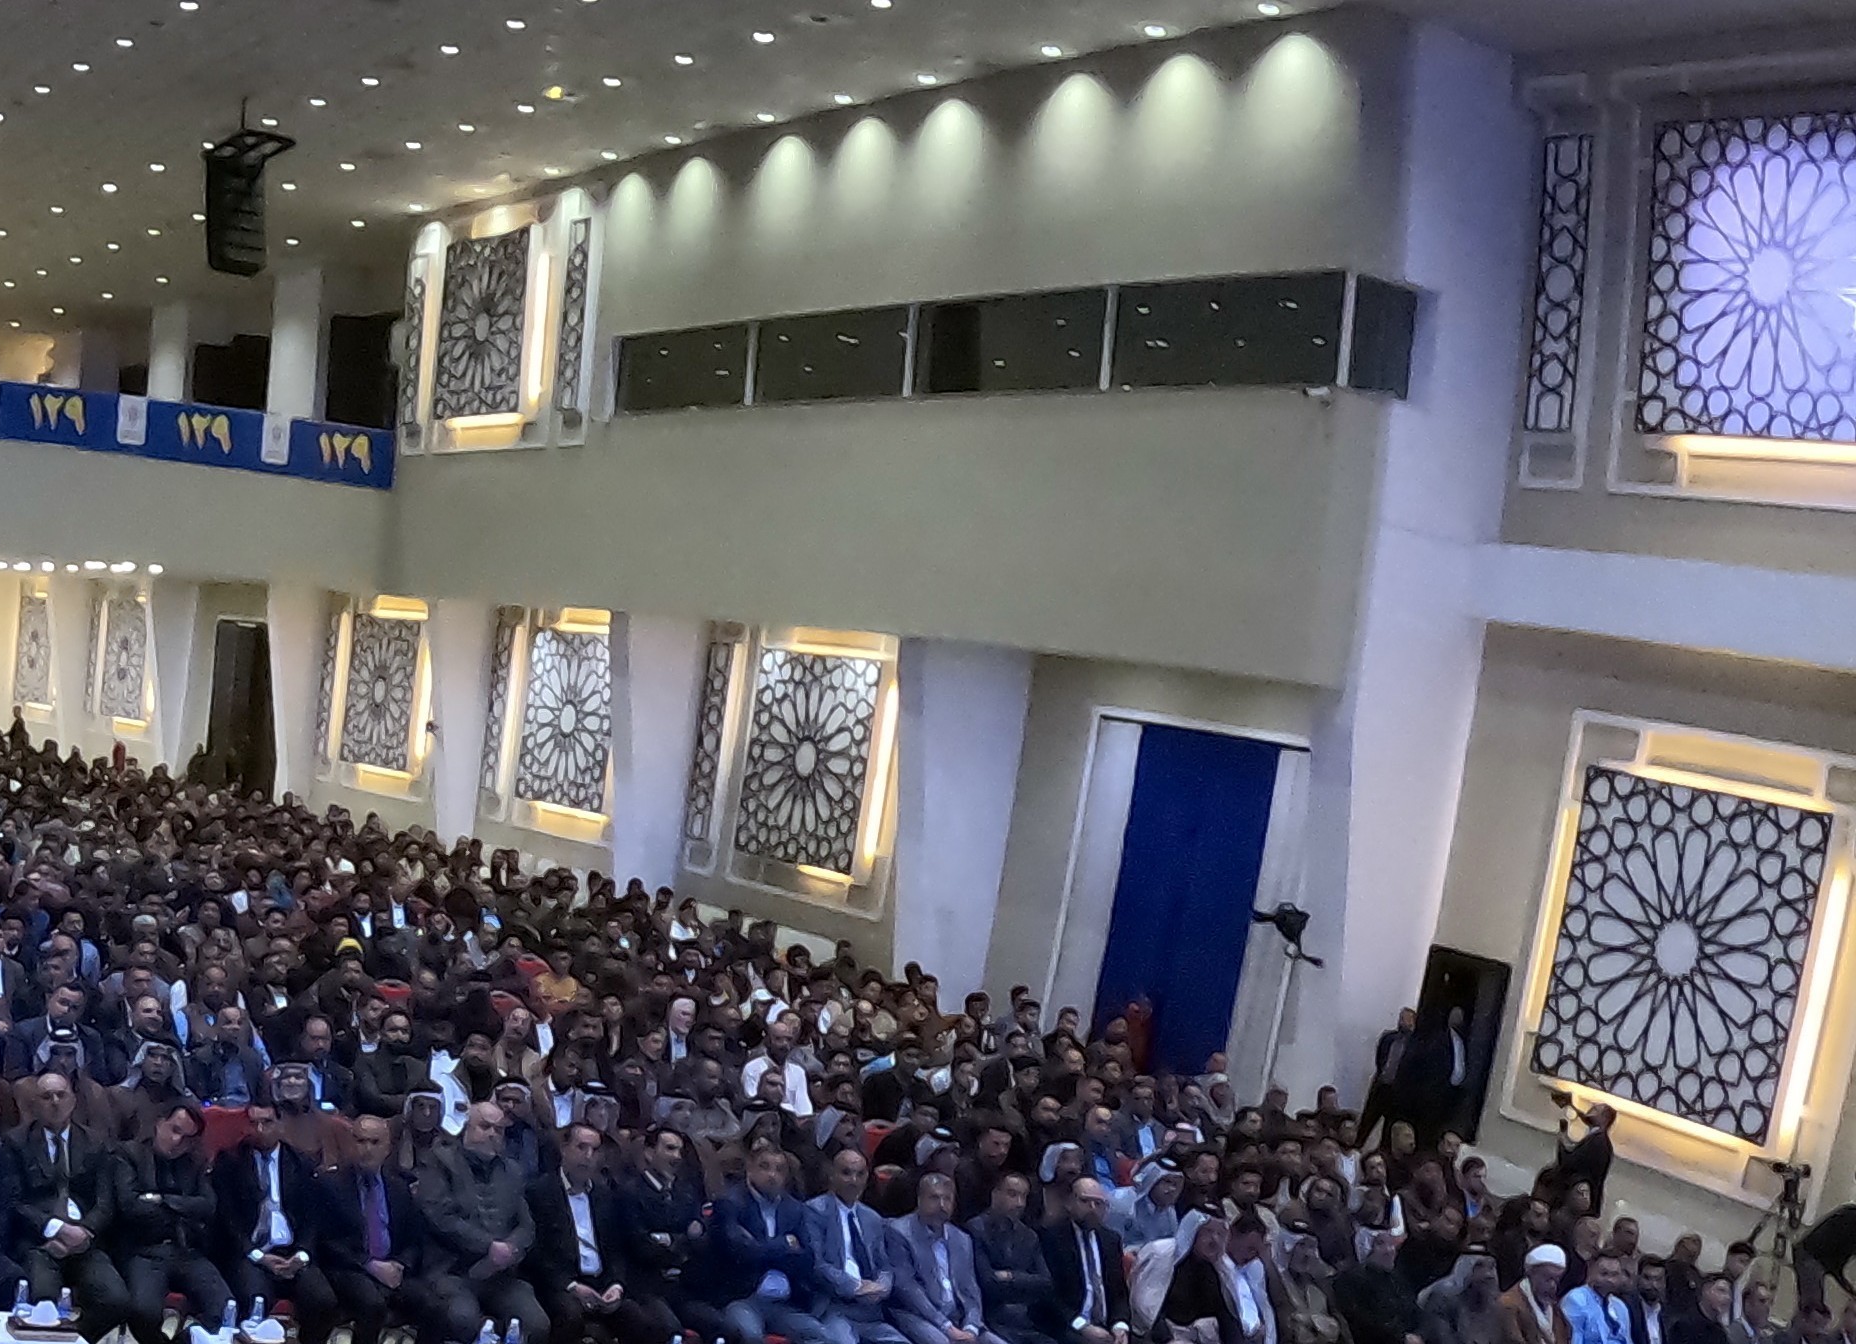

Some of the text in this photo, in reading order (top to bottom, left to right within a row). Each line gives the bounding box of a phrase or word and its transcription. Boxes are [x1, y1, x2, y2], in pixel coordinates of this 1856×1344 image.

[30, 394, 85, 436] ١٢٩
[178, 414, 231, 454] ١٢٩
[319, 433, 371, 474] ١٢٩
